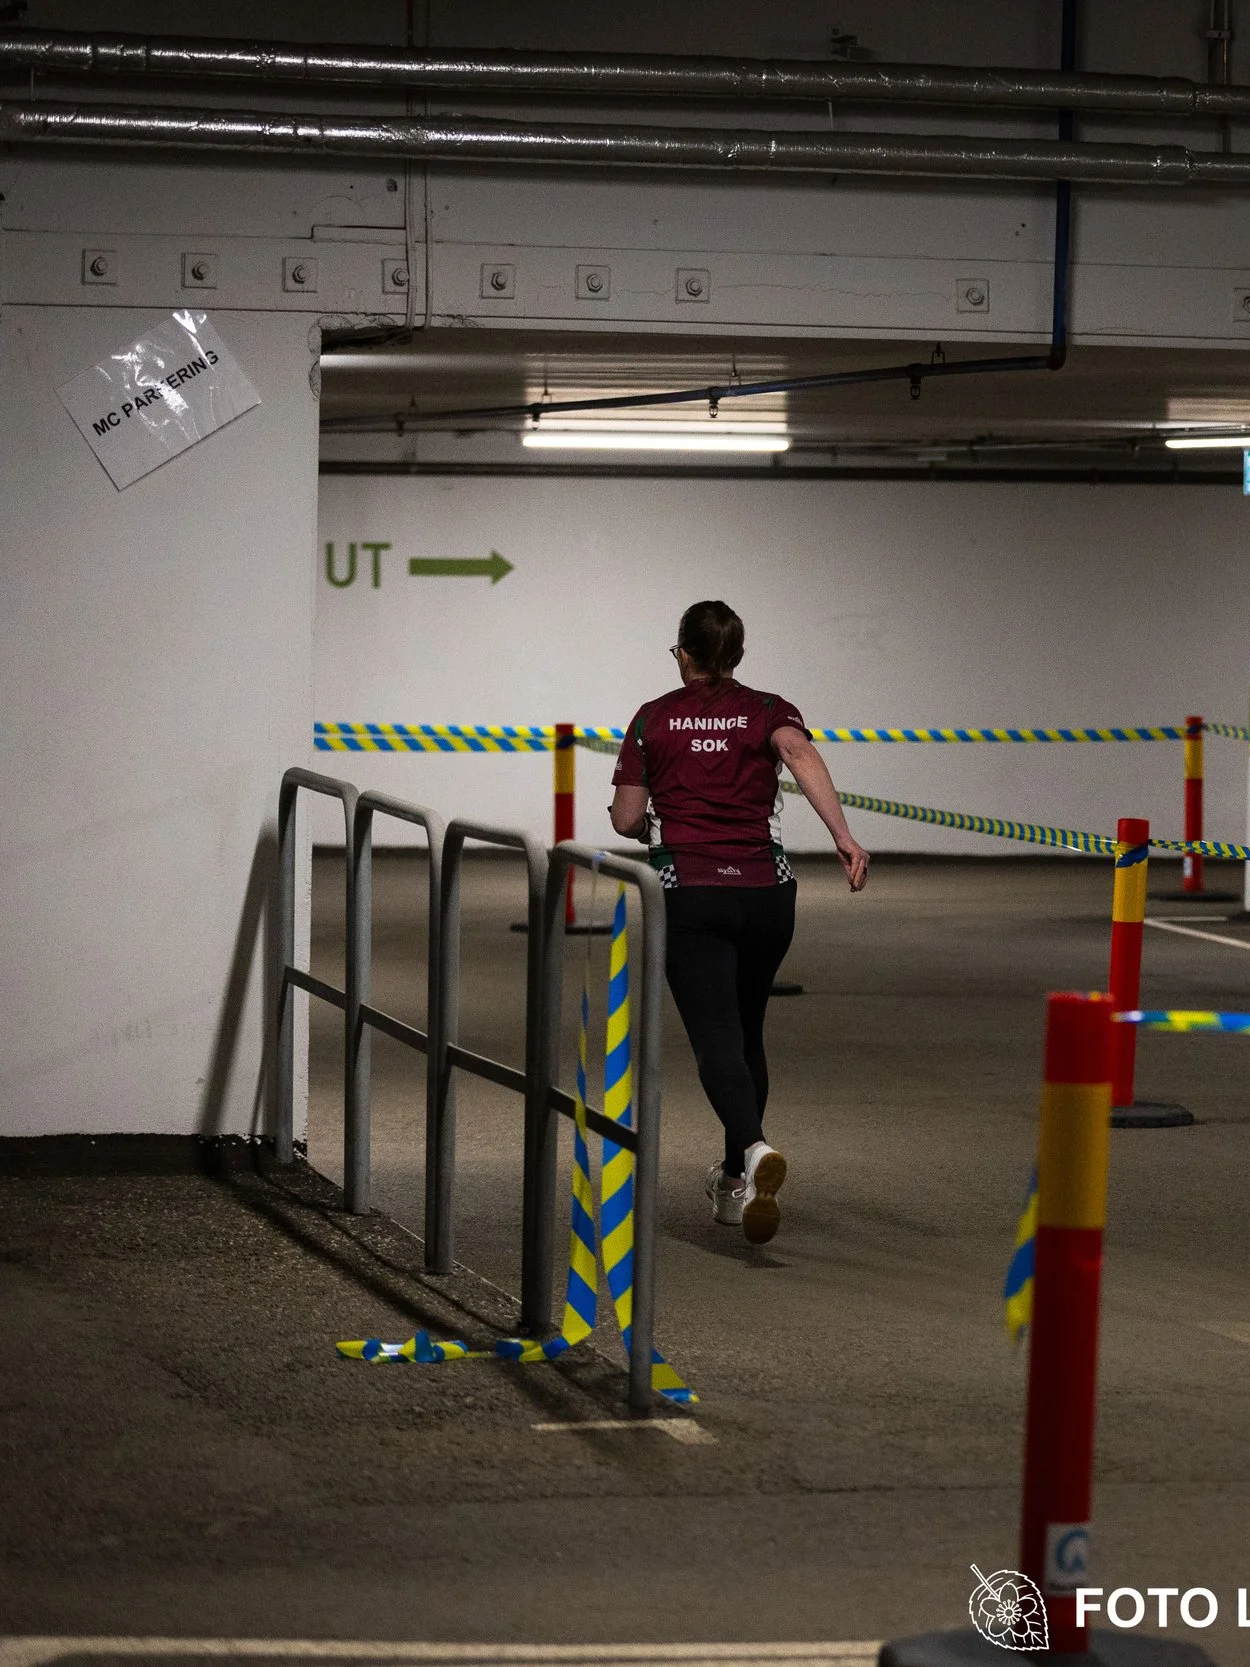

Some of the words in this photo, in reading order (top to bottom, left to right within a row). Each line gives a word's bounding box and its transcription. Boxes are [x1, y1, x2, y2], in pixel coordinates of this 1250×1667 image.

[93, 412, 121, 436] MC
[325, 542, 392, 590] UT
[691, 738, 728, 752] SOK
